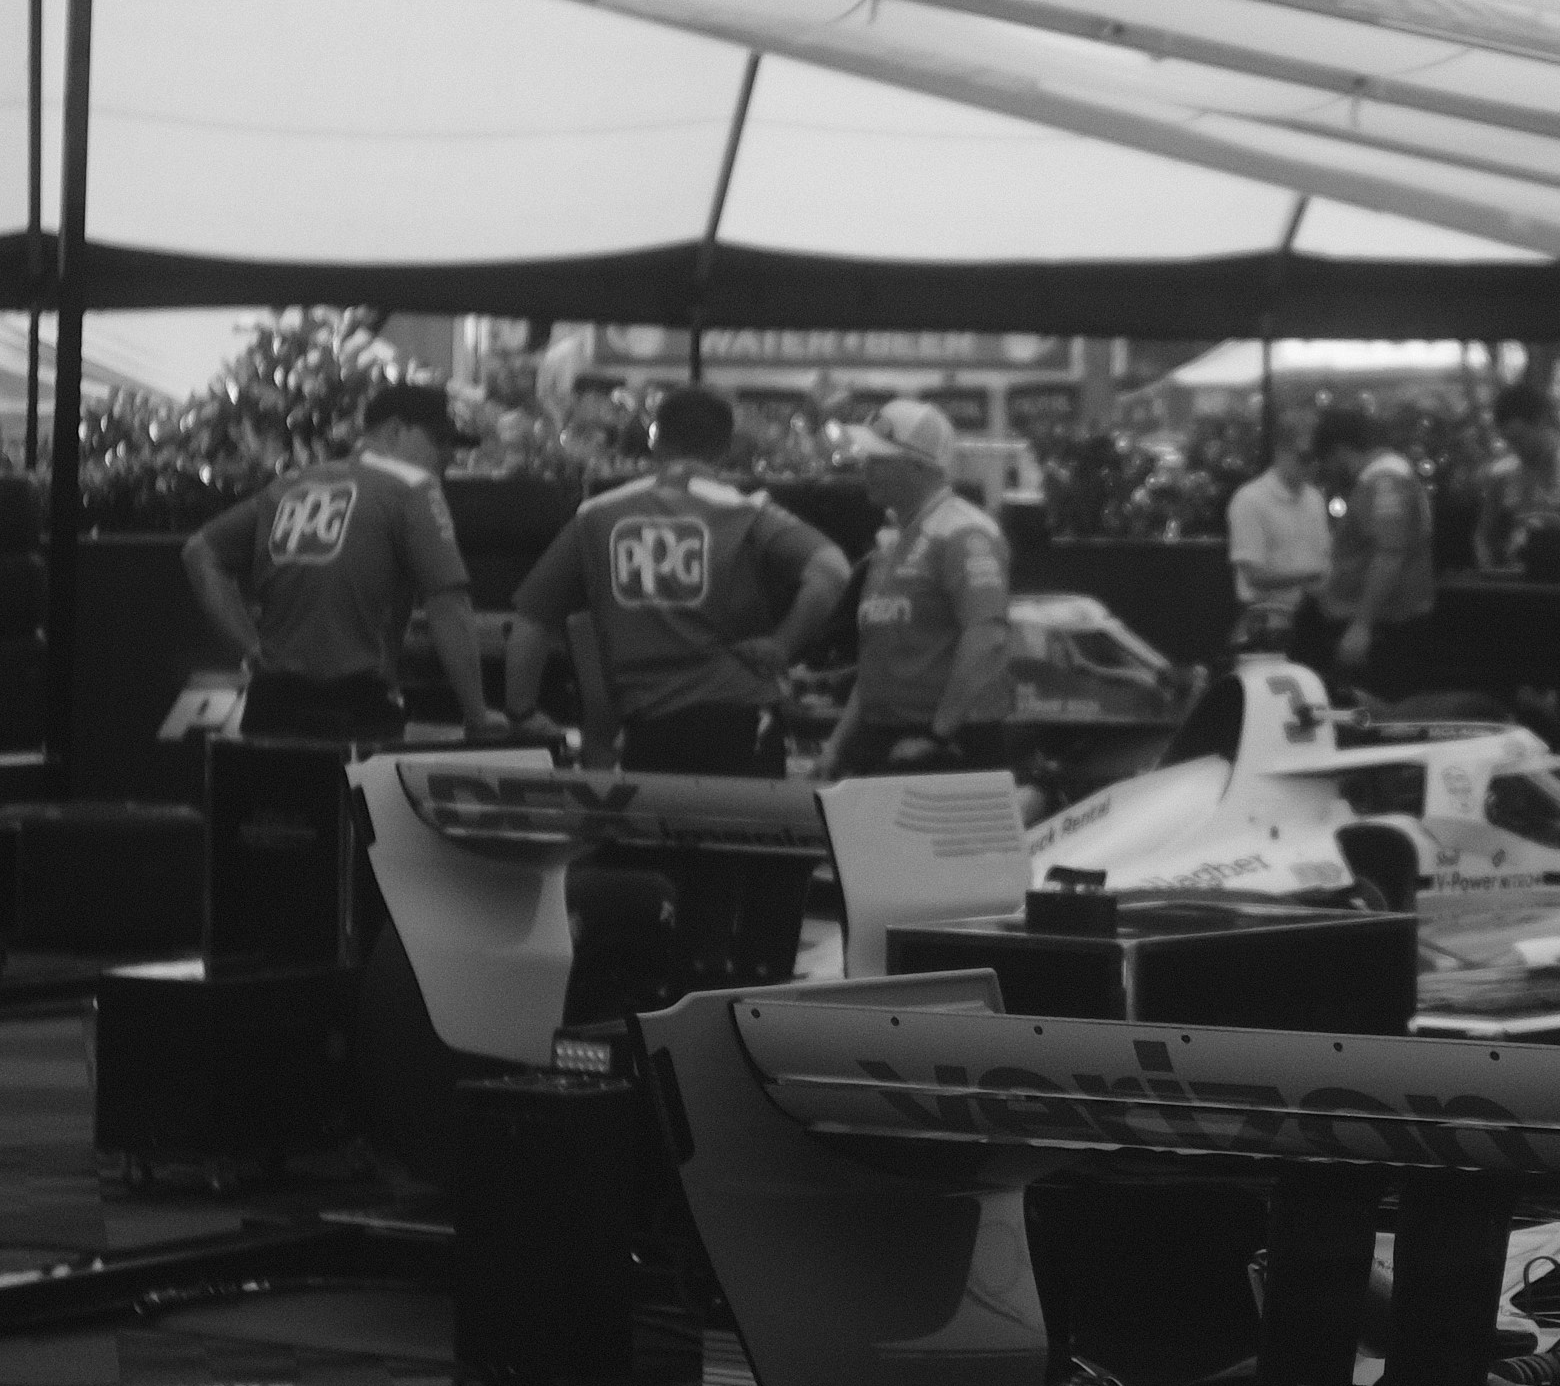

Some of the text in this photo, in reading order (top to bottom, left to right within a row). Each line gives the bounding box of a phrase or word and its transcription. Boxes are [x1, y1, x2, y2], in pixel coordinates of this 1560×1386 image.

[274, 491, 348, 554] PPG
[616, 527, 701, 595] PPG
[857, 1040, 1548, 1171] verizon
